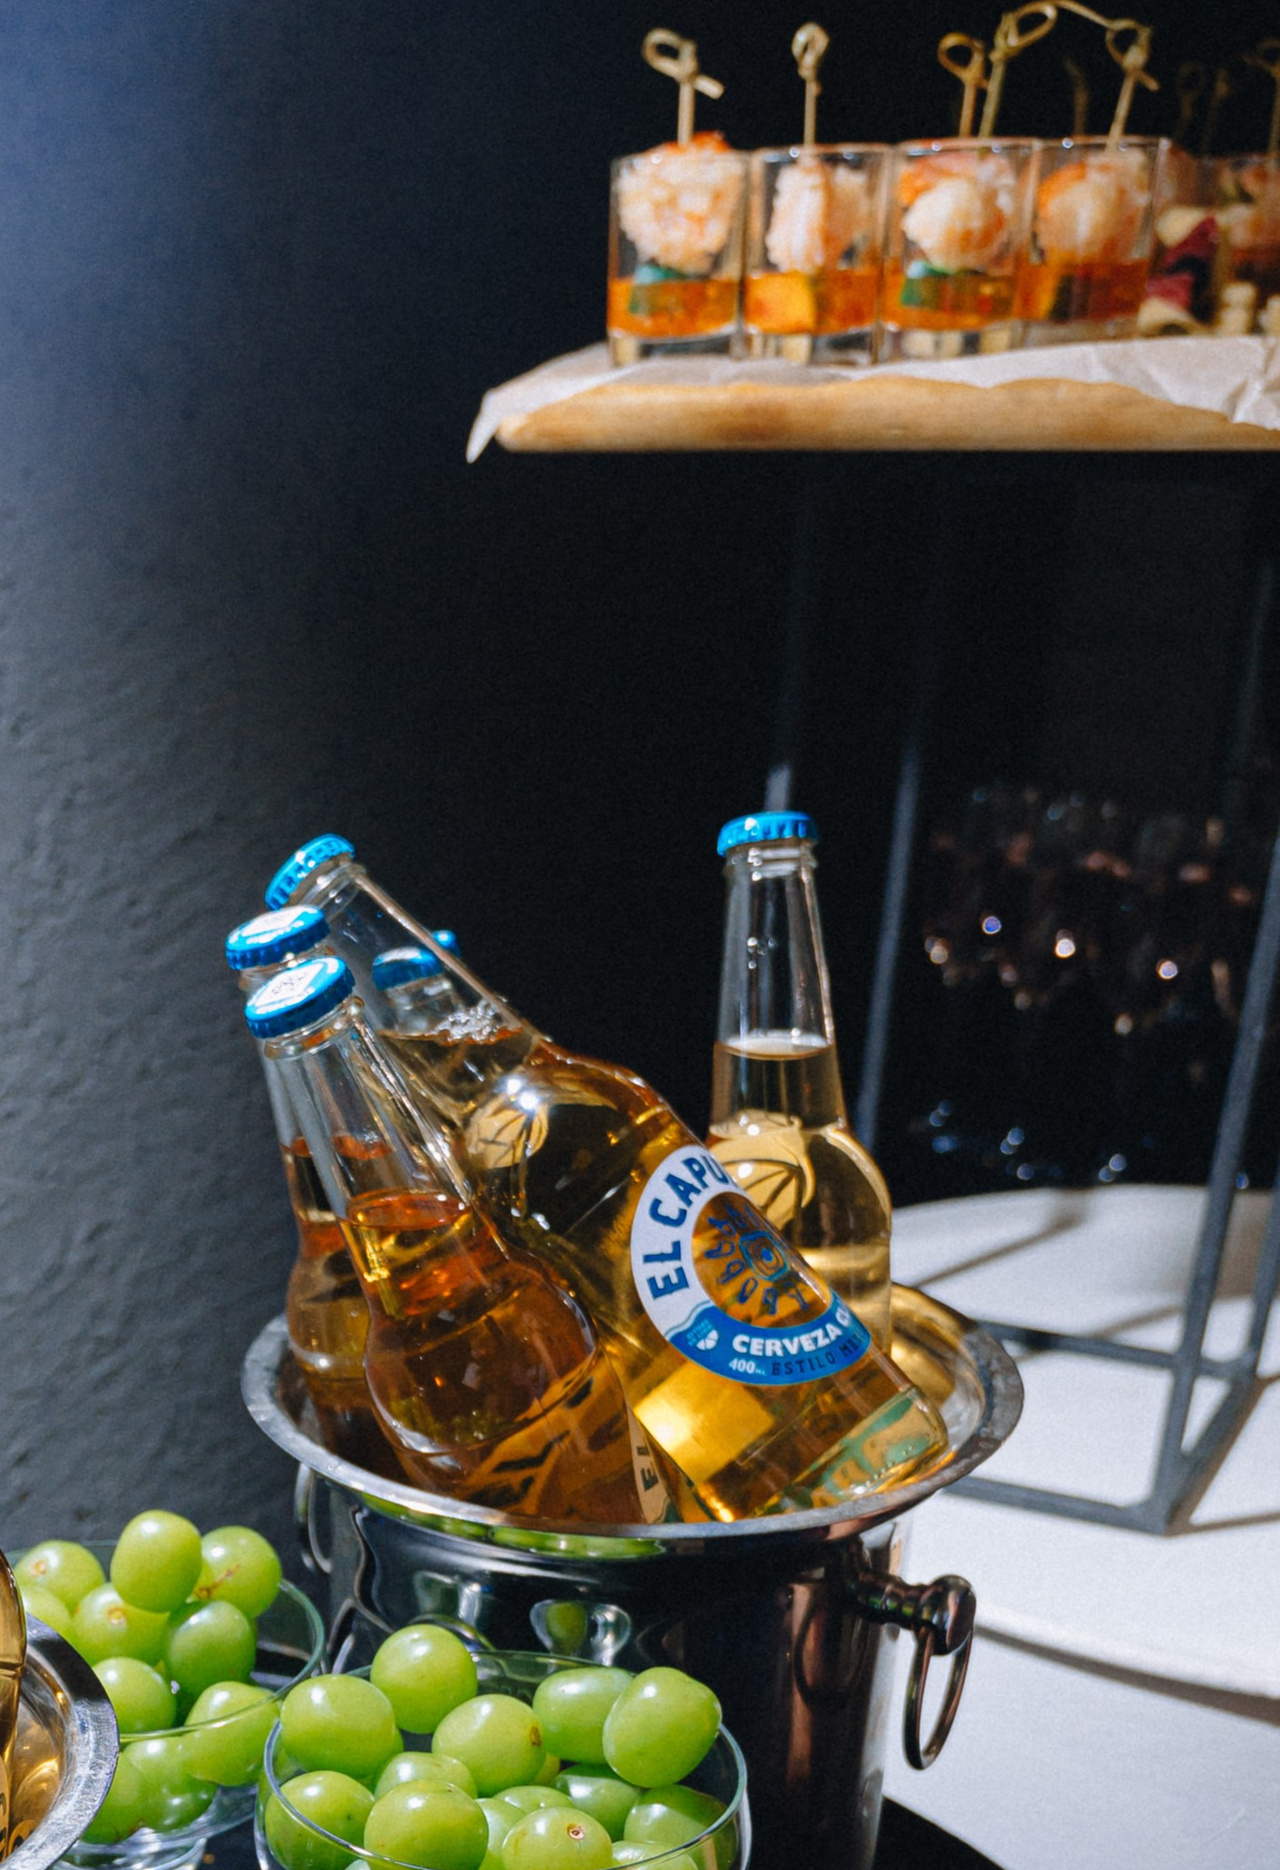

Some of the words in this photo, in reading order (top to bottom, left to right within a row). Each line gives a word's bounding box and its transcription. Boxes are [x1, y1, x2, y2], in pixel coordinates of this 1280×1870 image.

[648, 1155, 729, 1228] CAPU
[643, 1240, 689, 1300] EL
[732, 1323, 843, 1357] CERVEZA
[771, 1352, 836, 1376] ESTILO
